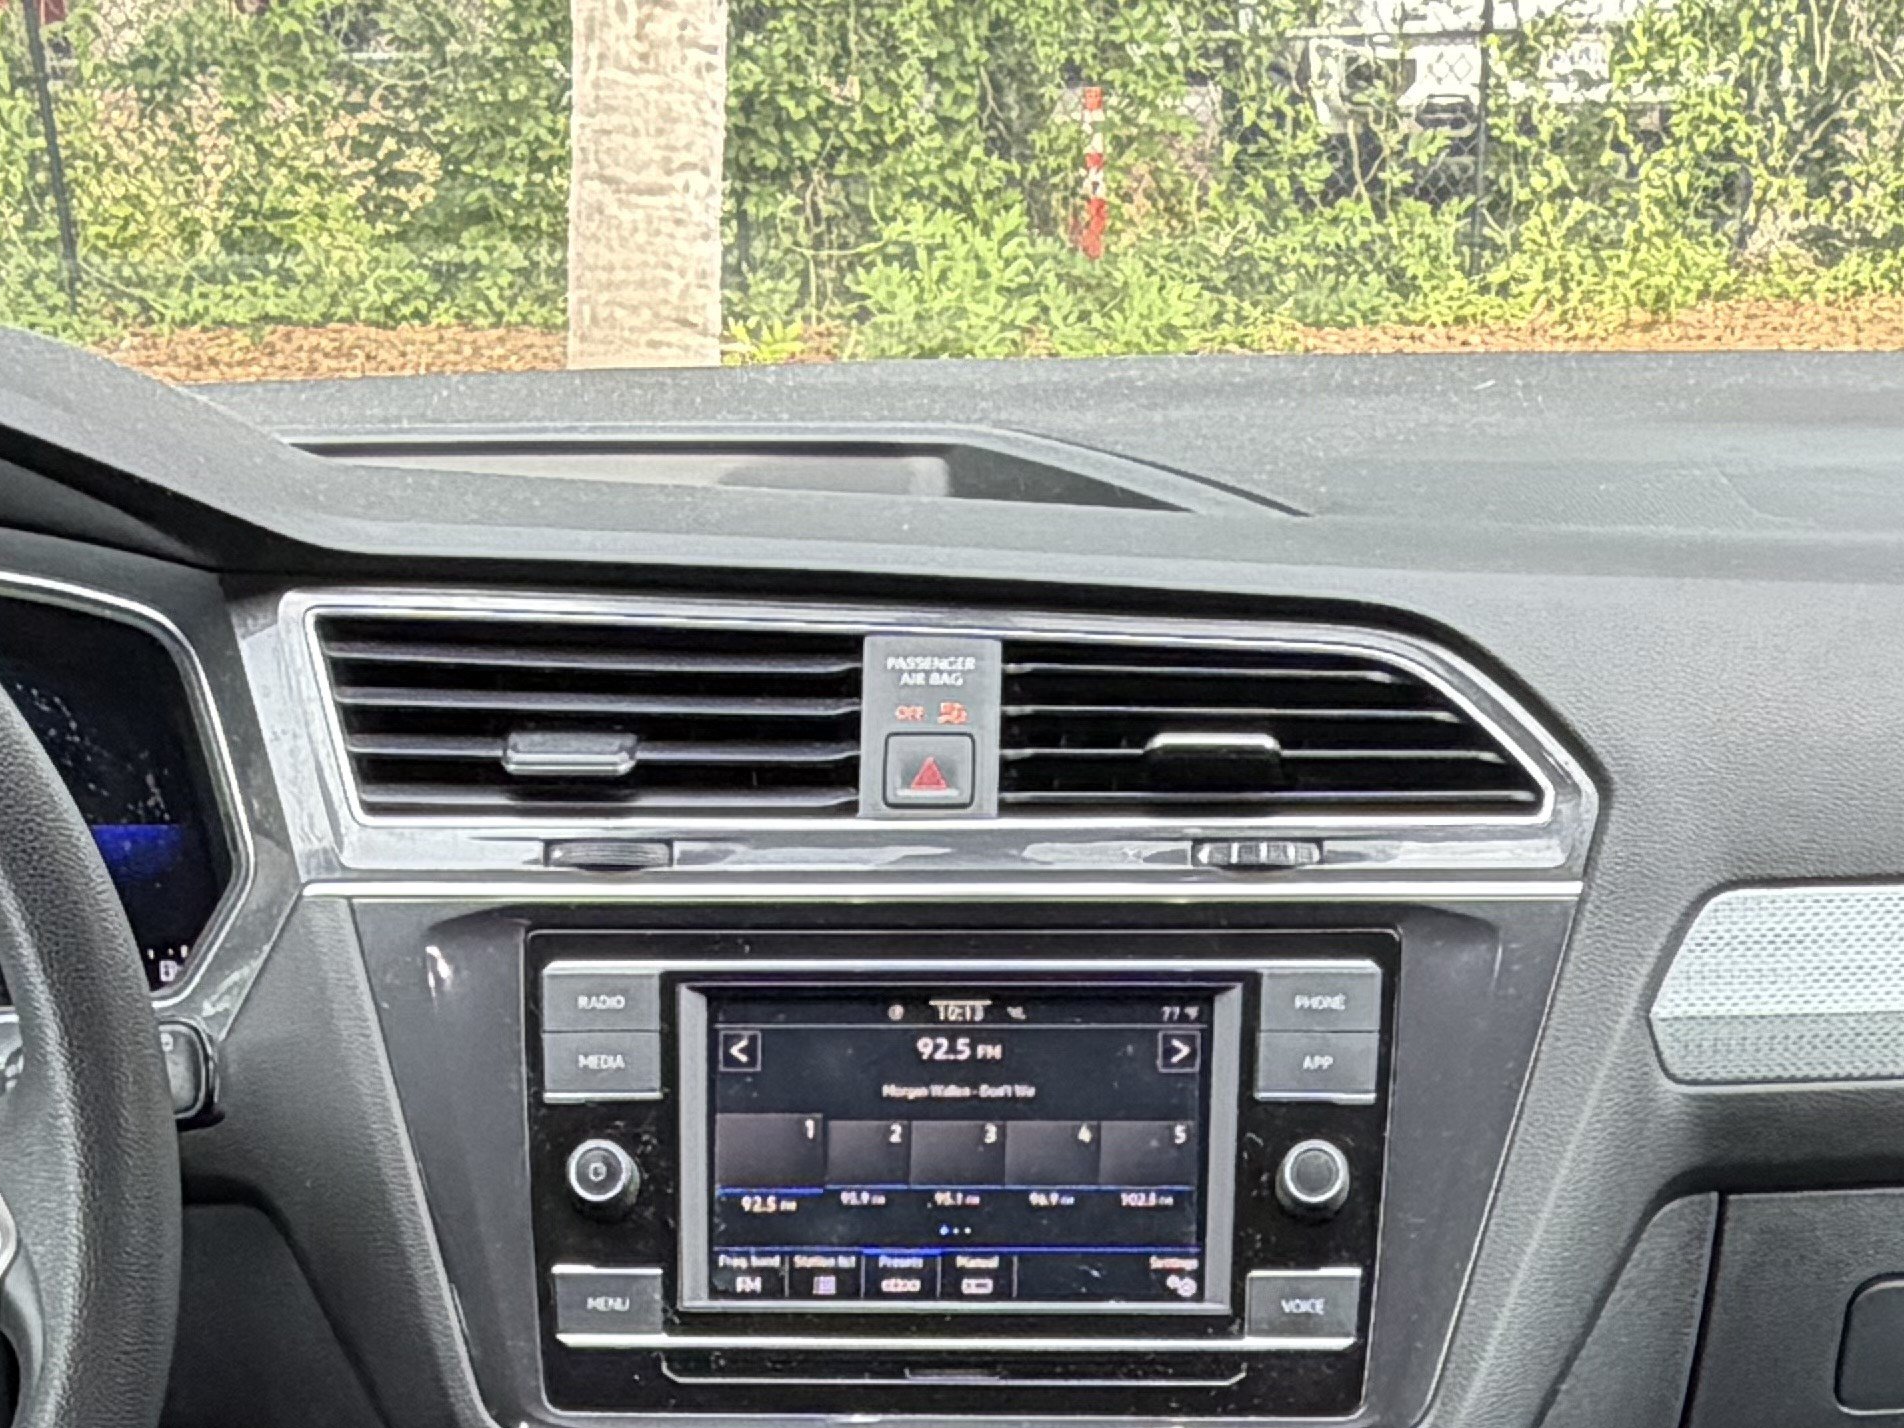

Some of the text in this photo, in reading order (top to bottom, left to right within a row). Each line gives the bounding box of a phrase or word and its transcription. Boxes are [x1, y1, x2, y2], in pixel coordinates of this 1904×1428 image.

[886, 656, 976, 671] PASSENGER
[900, 673, 964, 687] AIR BAG
[895, 705, 926, 721] OFF
[578, 995, 626, 1010] RADIO
[1294, 994, 1346, 1010] PHONE
[916, 1036, 1002, 1060] 92.5 FM
[578, 1054, 626, 1069] MEDIA
[1302, 1055, 1334, 1070] APP
[804, 1118, 815, 1139] 1
[889, 1122, 902, 1143] 2
[984, 1123, 997, 1143] 3
[1078, 1123, 1092, 1143] 4
[1174, 1124, 1187, 1144] 5
[740, 1195, 777, 1213] 92.5
[735, 1276, 762, 1293] FM
[586, 1296, 630, 1311] MENU
[1281, 1299, 1325, 1315] VOICE
